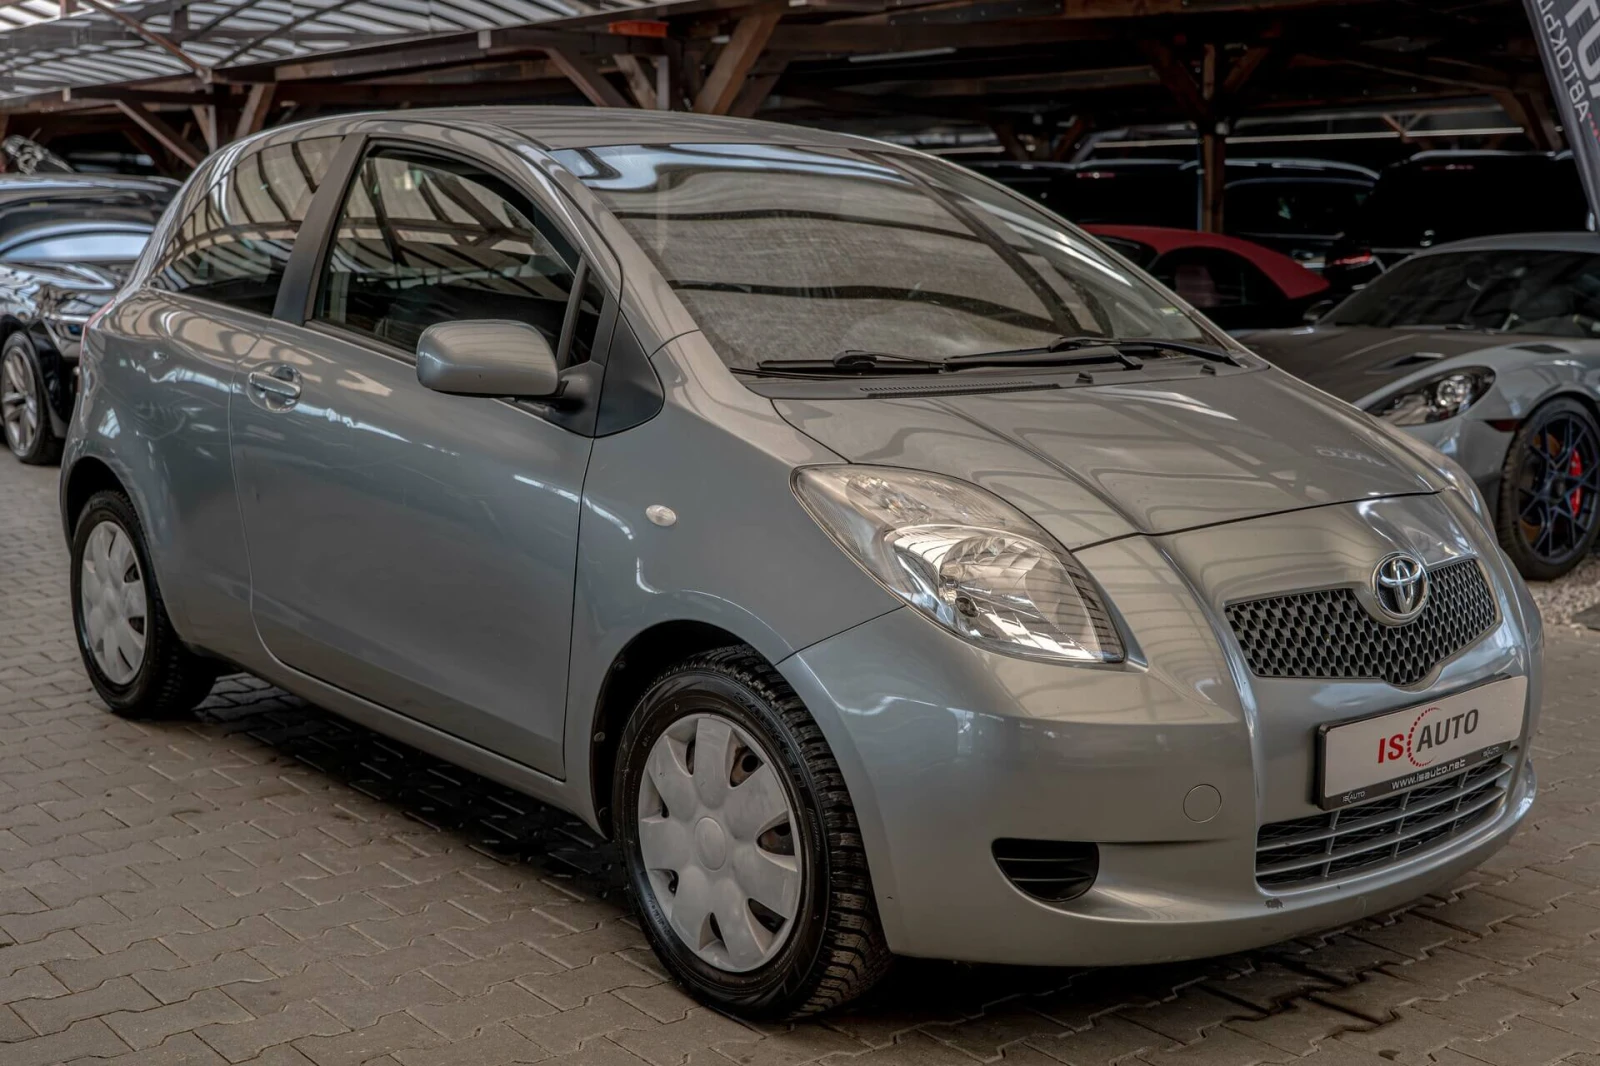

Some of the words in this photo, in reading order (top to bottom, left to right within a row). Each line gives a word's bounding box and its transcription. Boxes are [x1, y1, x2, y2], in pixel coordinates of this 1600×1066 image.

[1377, 733, 1405, 764] IS
[1416, 708, 1479, 753] AUTO
[1391, 758, 1466, 790] www.isauto.net
